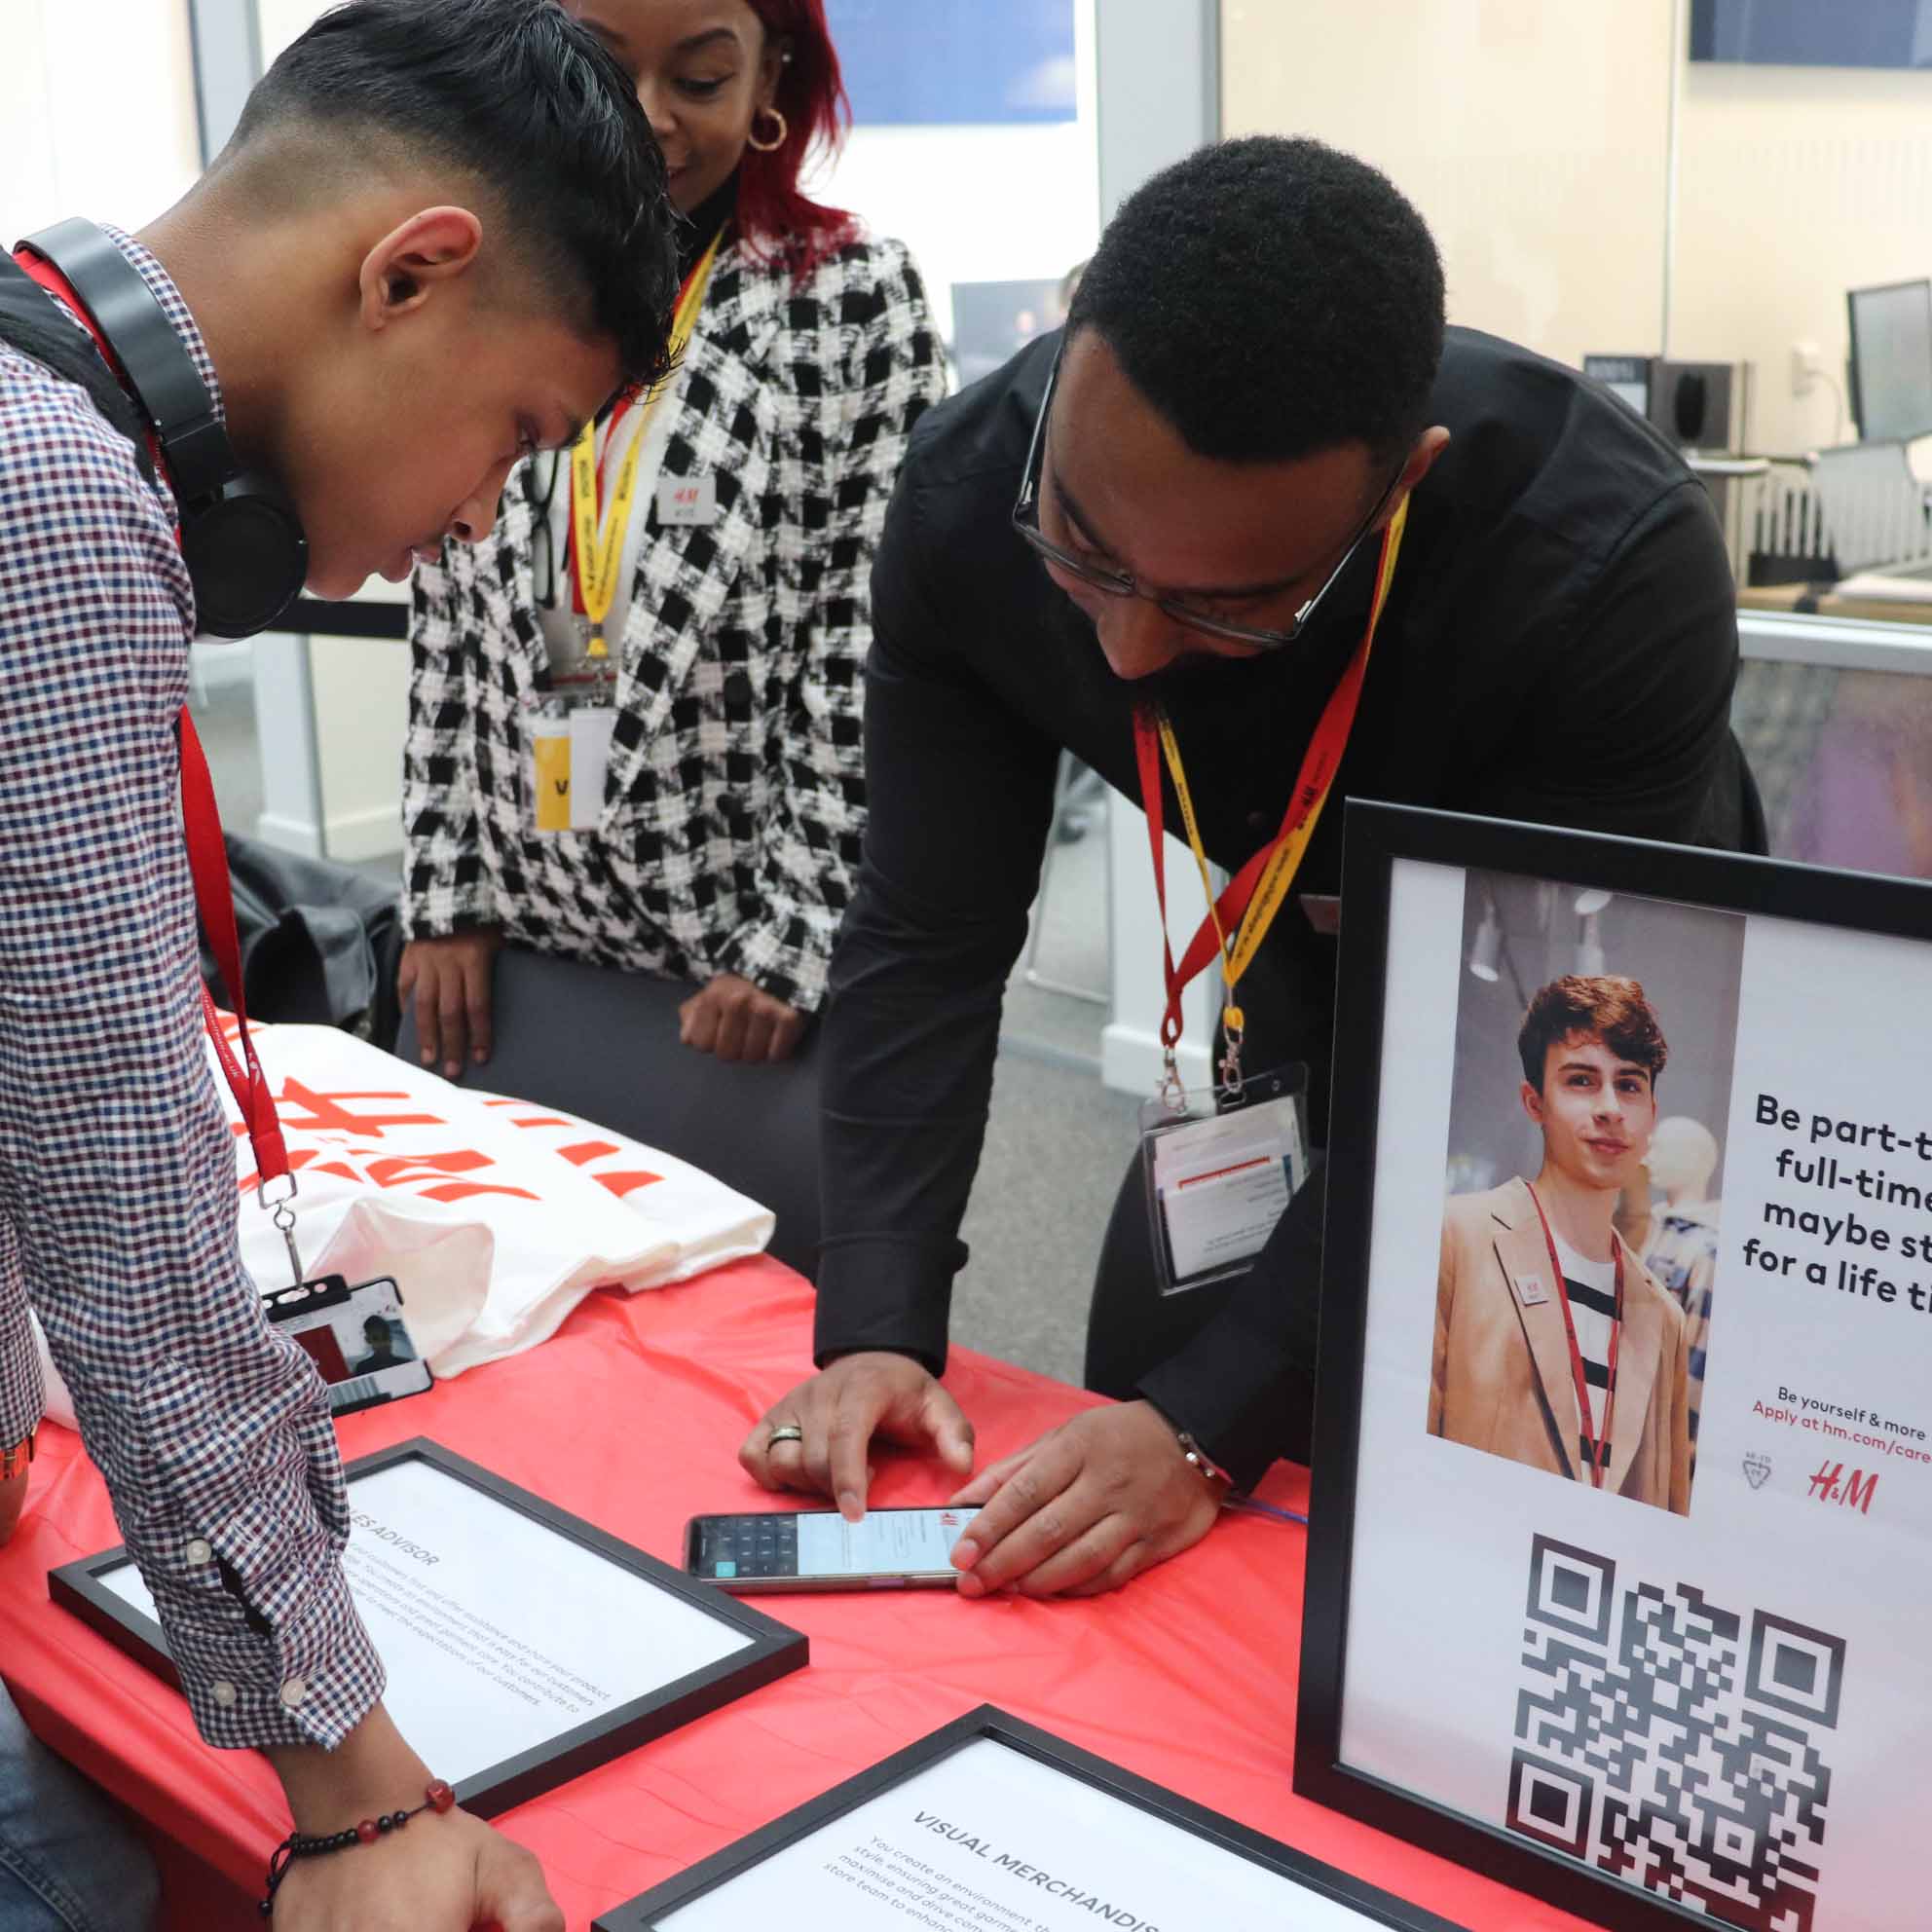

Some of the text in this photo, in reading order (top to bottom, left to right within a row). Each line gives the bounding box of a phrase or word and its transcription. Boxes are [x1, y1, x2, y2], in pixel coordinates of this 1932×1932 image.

[1756, 1093, 1932, 1162] Be part-t
[1764, 1202, 1891, 1251] maybe
[1742, 1238, 1797, 1276] for
[1805, 1262, 1827, 1286] a
[1838, 1260, 1897, 1303] life
[1752, 1400, 1798, 1427] Apply
[1802, 1416, 1819, 1431] at
[1778, 1387, 1926, 1441] Be yourself & more
[1807, 1460, 1879, 1515] H&M
[369, 1526, 440, 1566] ADVISOR
[913, 1810, 991, 1858] VISUAL
[822, 1862, 856, 1882] store
[856, 1879, 889, 1902] team
[890, 1898, 906, 1910] to
[838, 1854, 896, 1886] maximise
[895, 1885, 925, 1902] and
[921, 1899, 954, 1918] drive
[871, 1835, 895, 1852] You
[893, 1850, 935, 1875] create
[934, 1873, 953, 1885] an
[951, 1882, 1033, 1927] environment
[886, 1863, 938, 1896] ensuring
[938, 1892, 977, 1914] great
